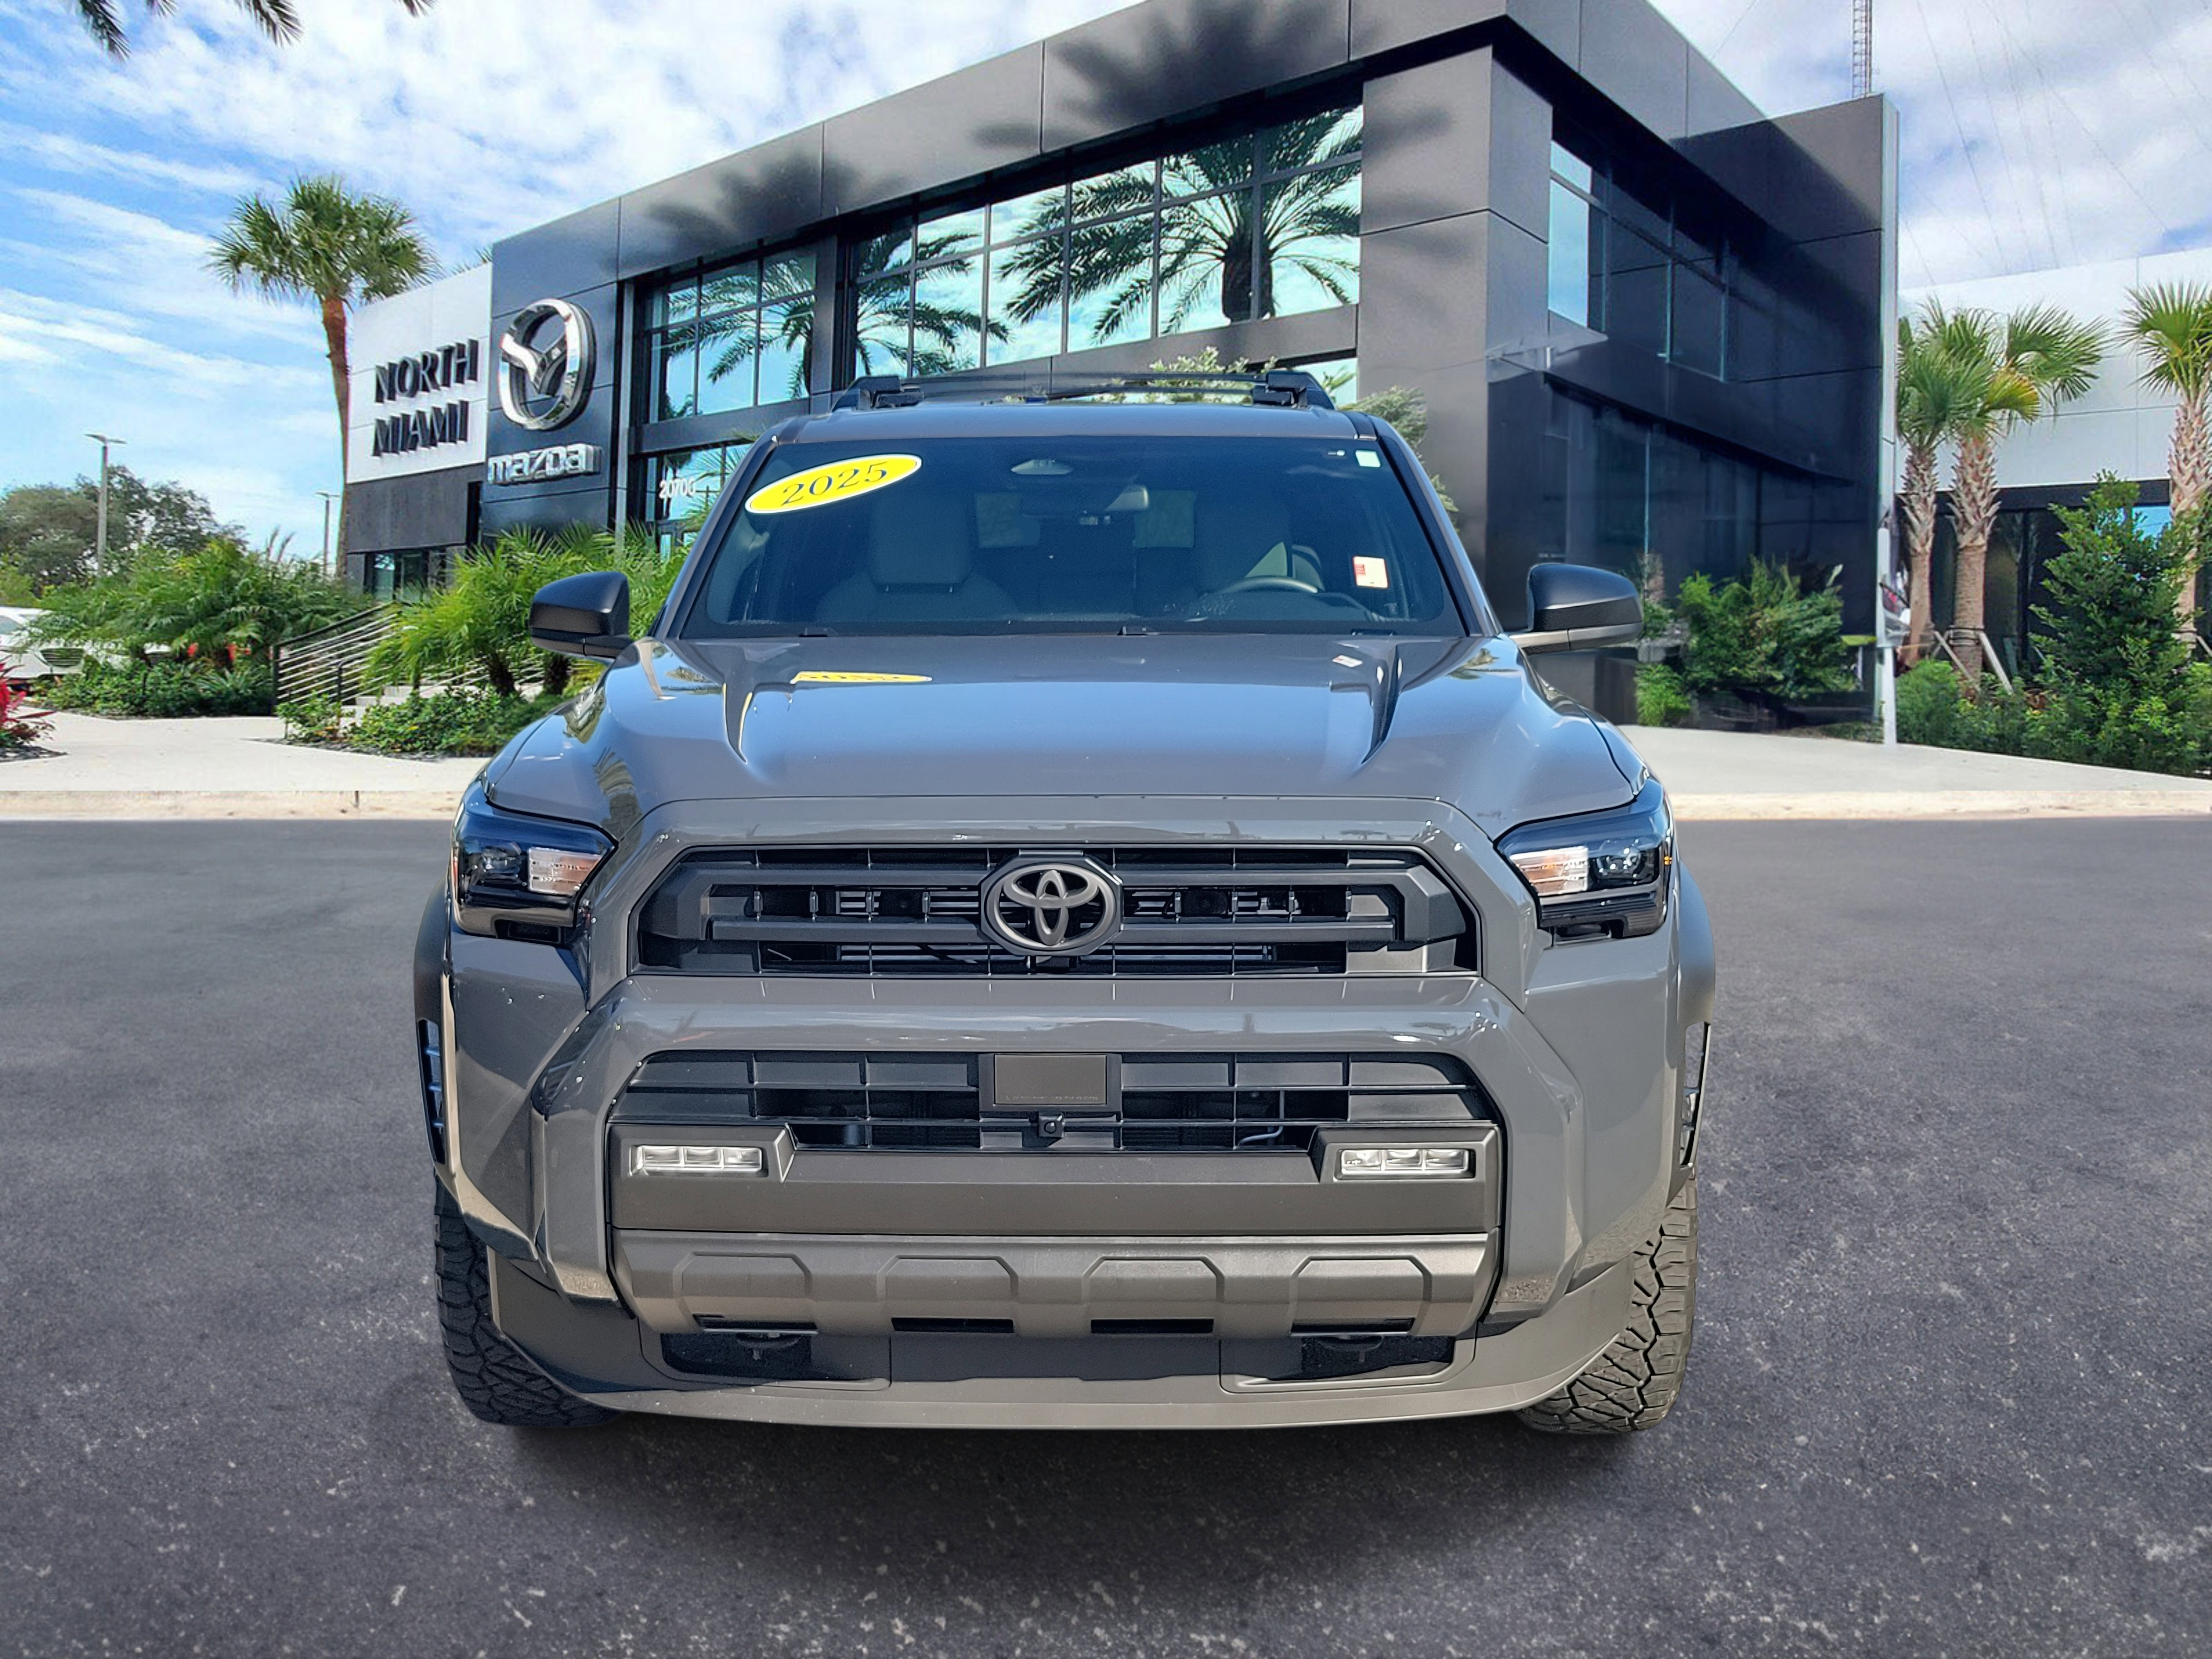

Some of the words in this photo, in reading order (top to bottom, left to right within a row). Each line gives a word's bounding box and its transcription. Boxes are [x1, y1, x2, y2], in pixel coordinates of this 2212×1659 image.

[374, 338, 479, 403] NORTH
[372, 400, 469, 456] MIAMI
[487, 443, 597, 485] mazda
[781, 461, 887, 506] 2025
